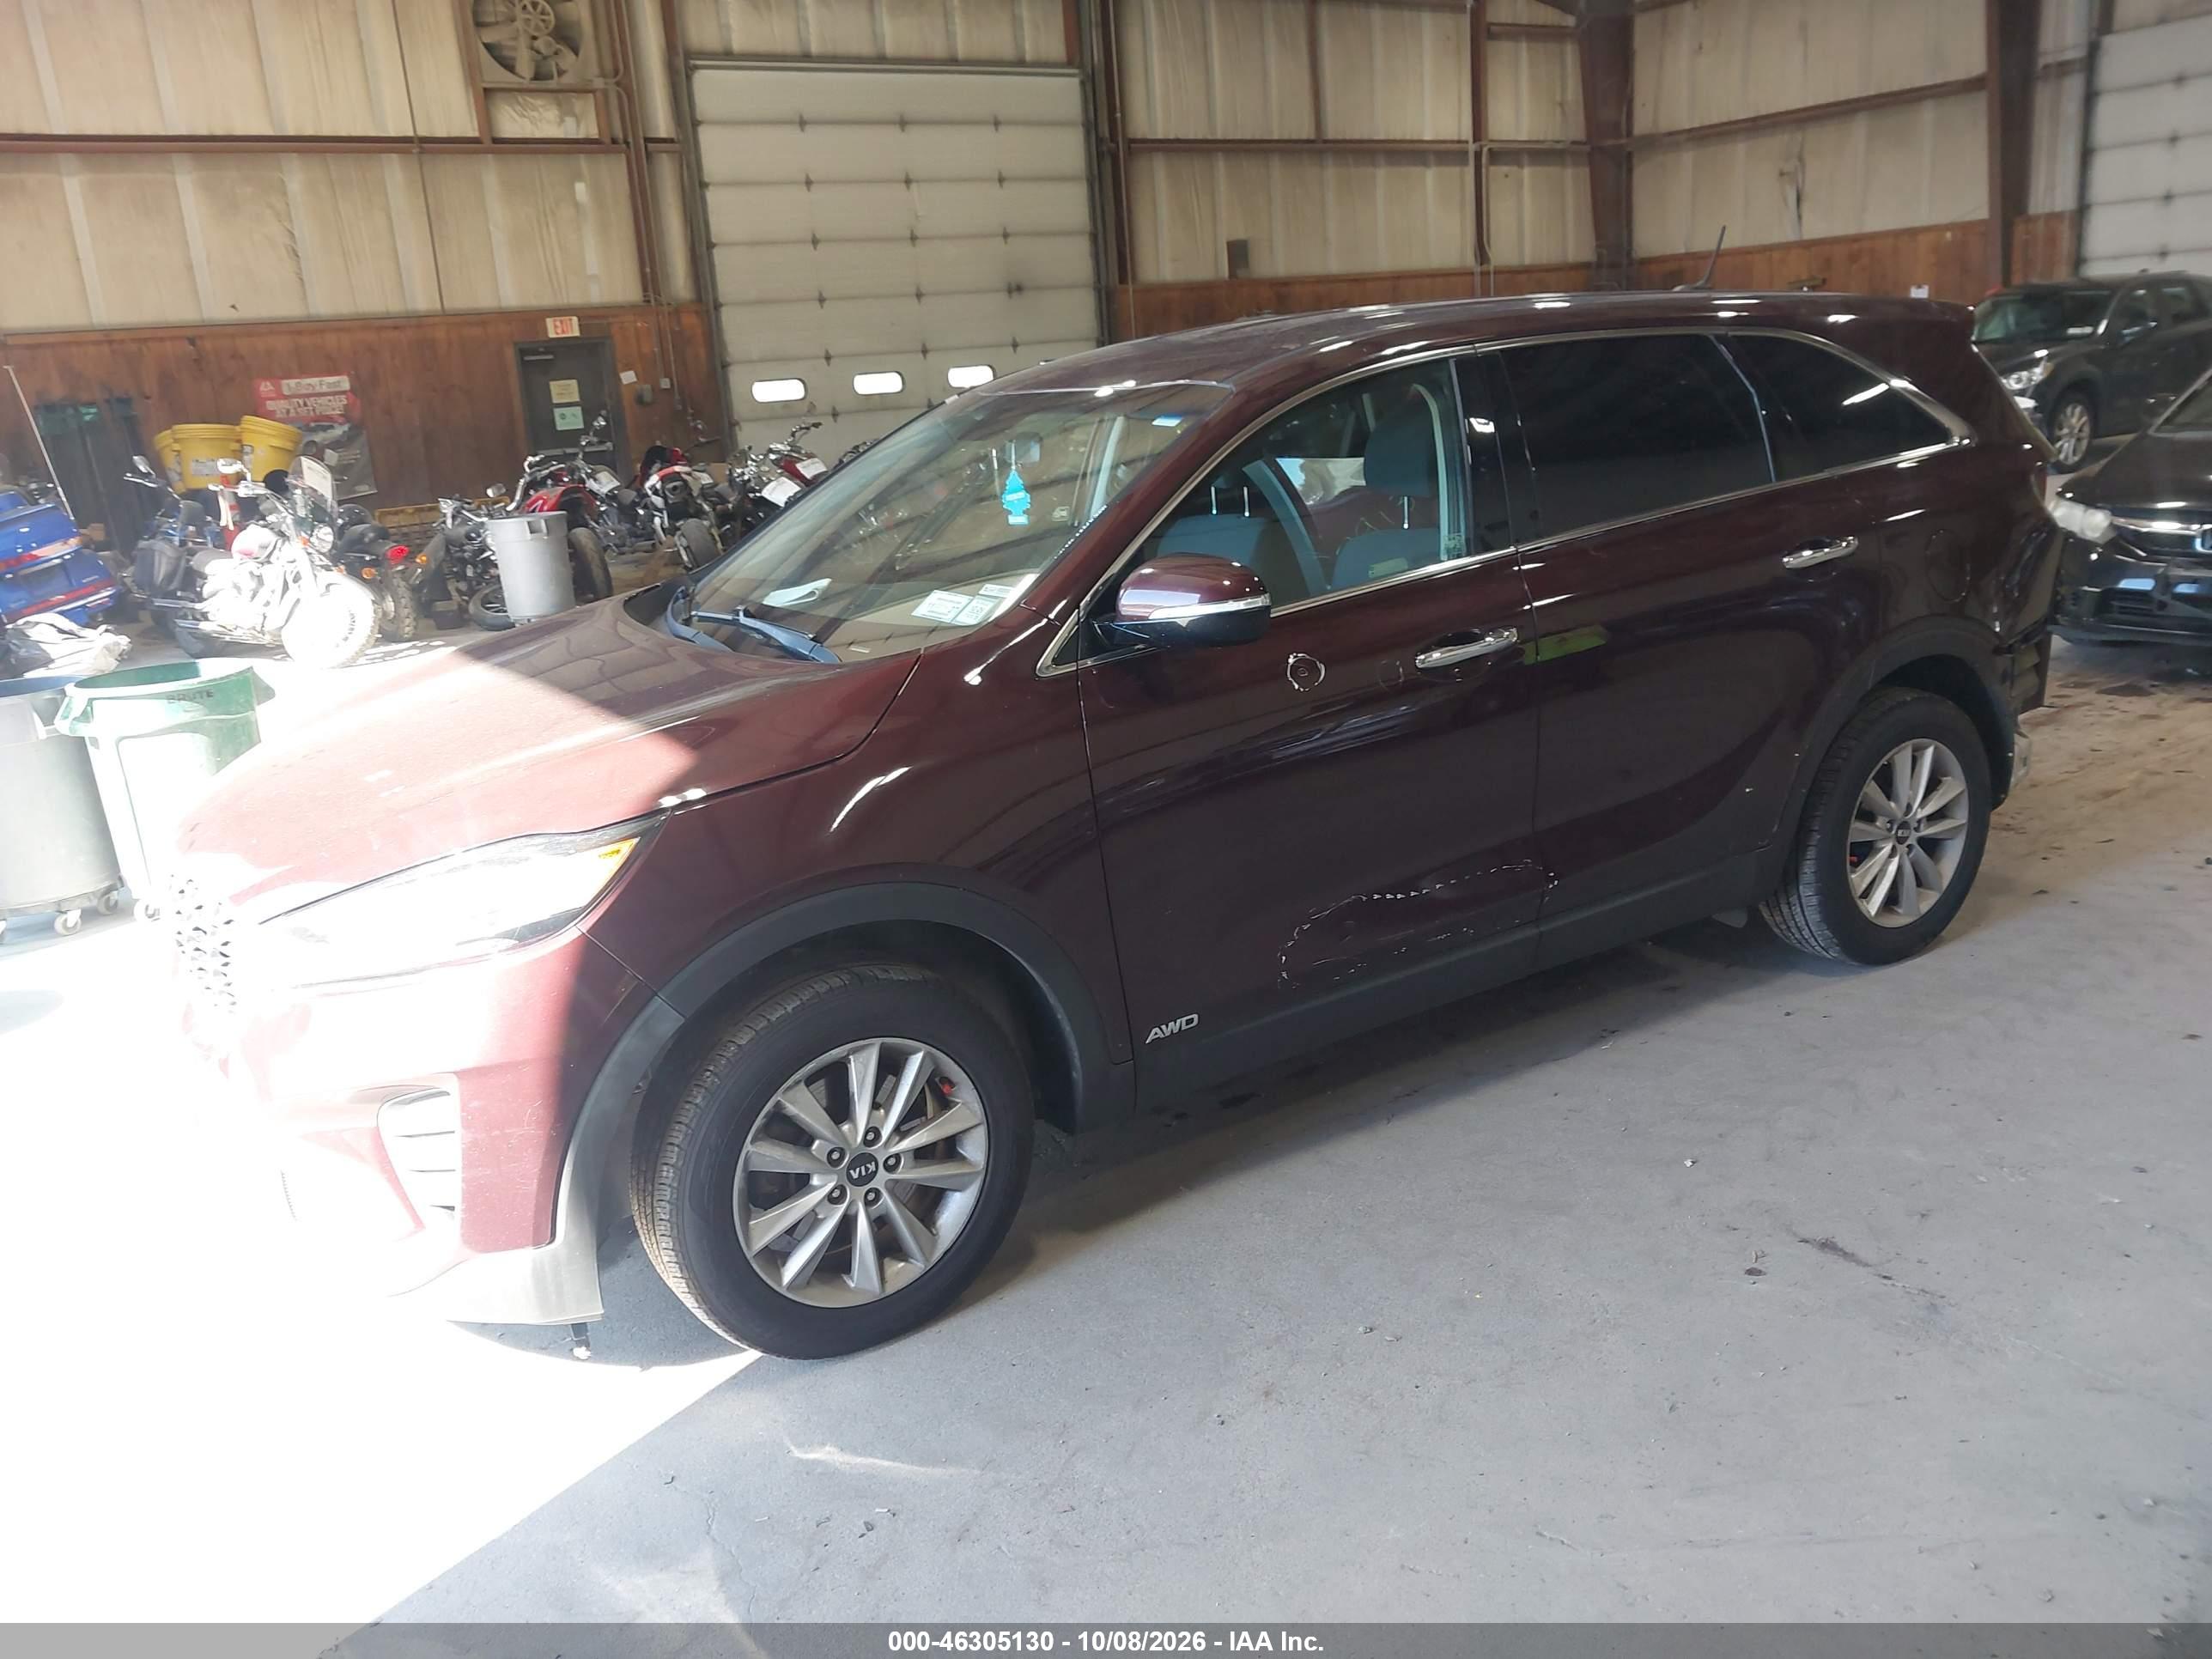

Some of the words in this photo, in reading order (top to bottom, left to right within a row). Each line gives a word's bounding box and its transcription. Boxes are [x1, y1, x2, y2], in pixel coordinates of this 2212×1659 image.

[552, 316, 574, 336] EXIT
[167, 690, 214, 703] BRUTE
[1145, 1013, 1199, 1044] AWD
